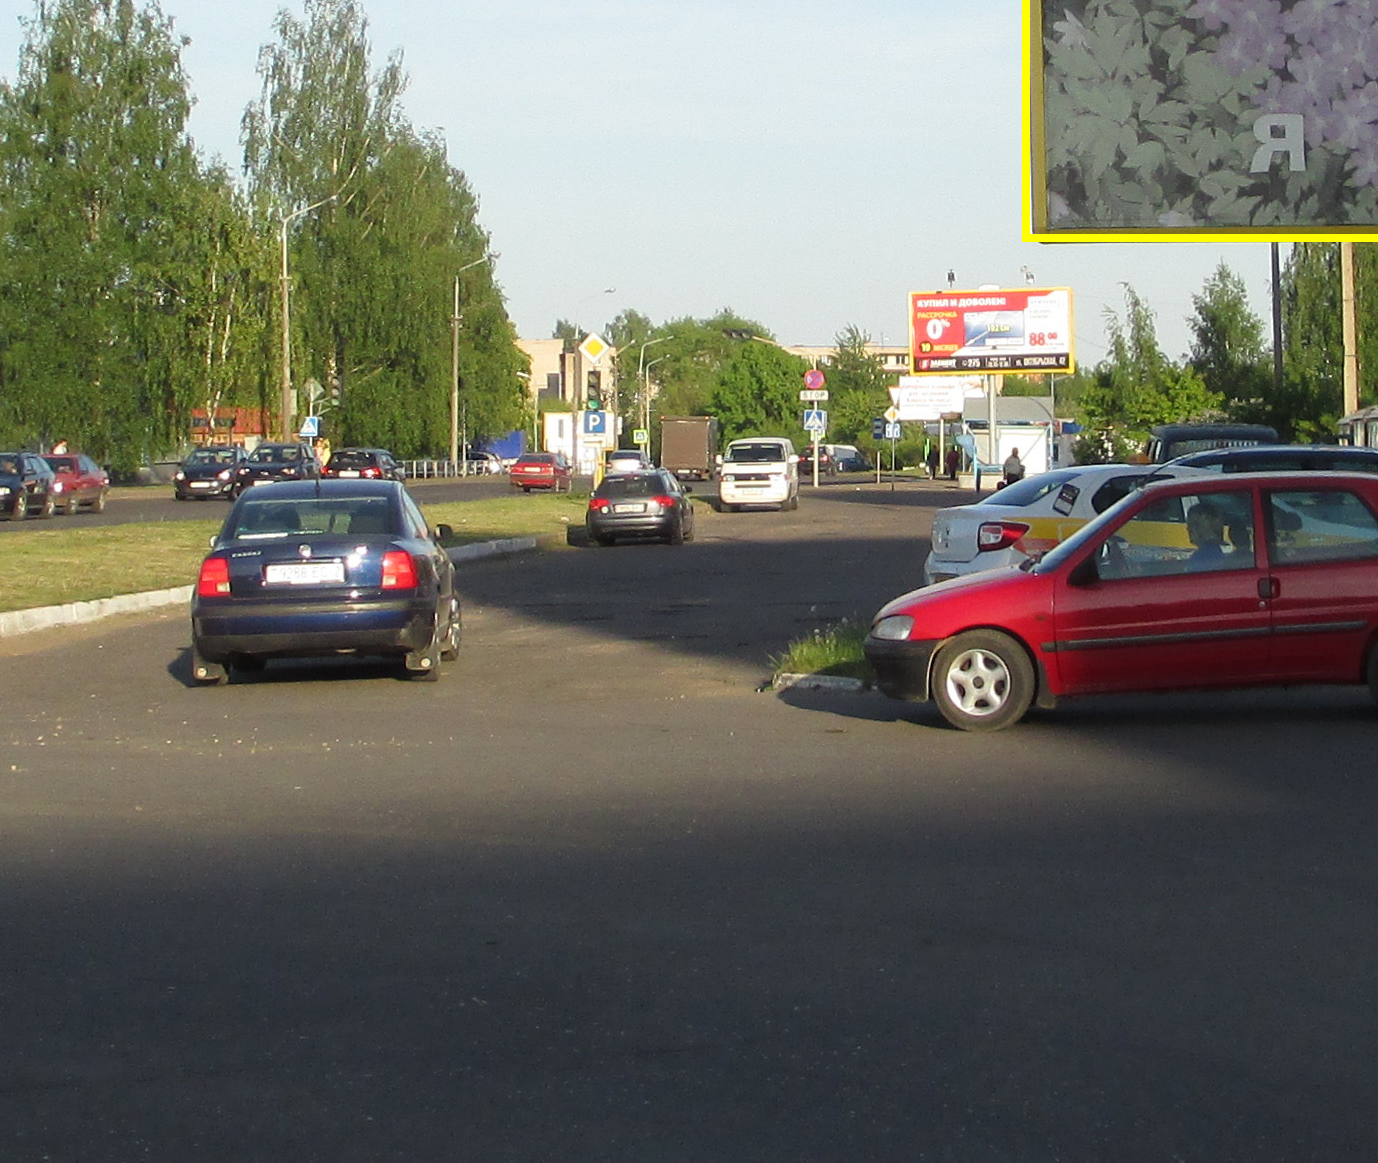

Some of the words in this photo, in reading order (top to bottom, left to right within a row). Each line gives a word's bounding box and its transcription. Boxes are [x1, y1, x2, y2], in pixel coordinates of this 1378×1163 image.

[1250, 113, 1307, 173] Я
[917, 298, 949, 308] КУПИЛ
[950, 298, 958, 307] И
[958, 297, 1007, 308] ДОВОЛЕН!
[927, 318, 951, 340] 0%
[1029, 332, 1045, 347] 88
[589, 414, 601, 431] P
